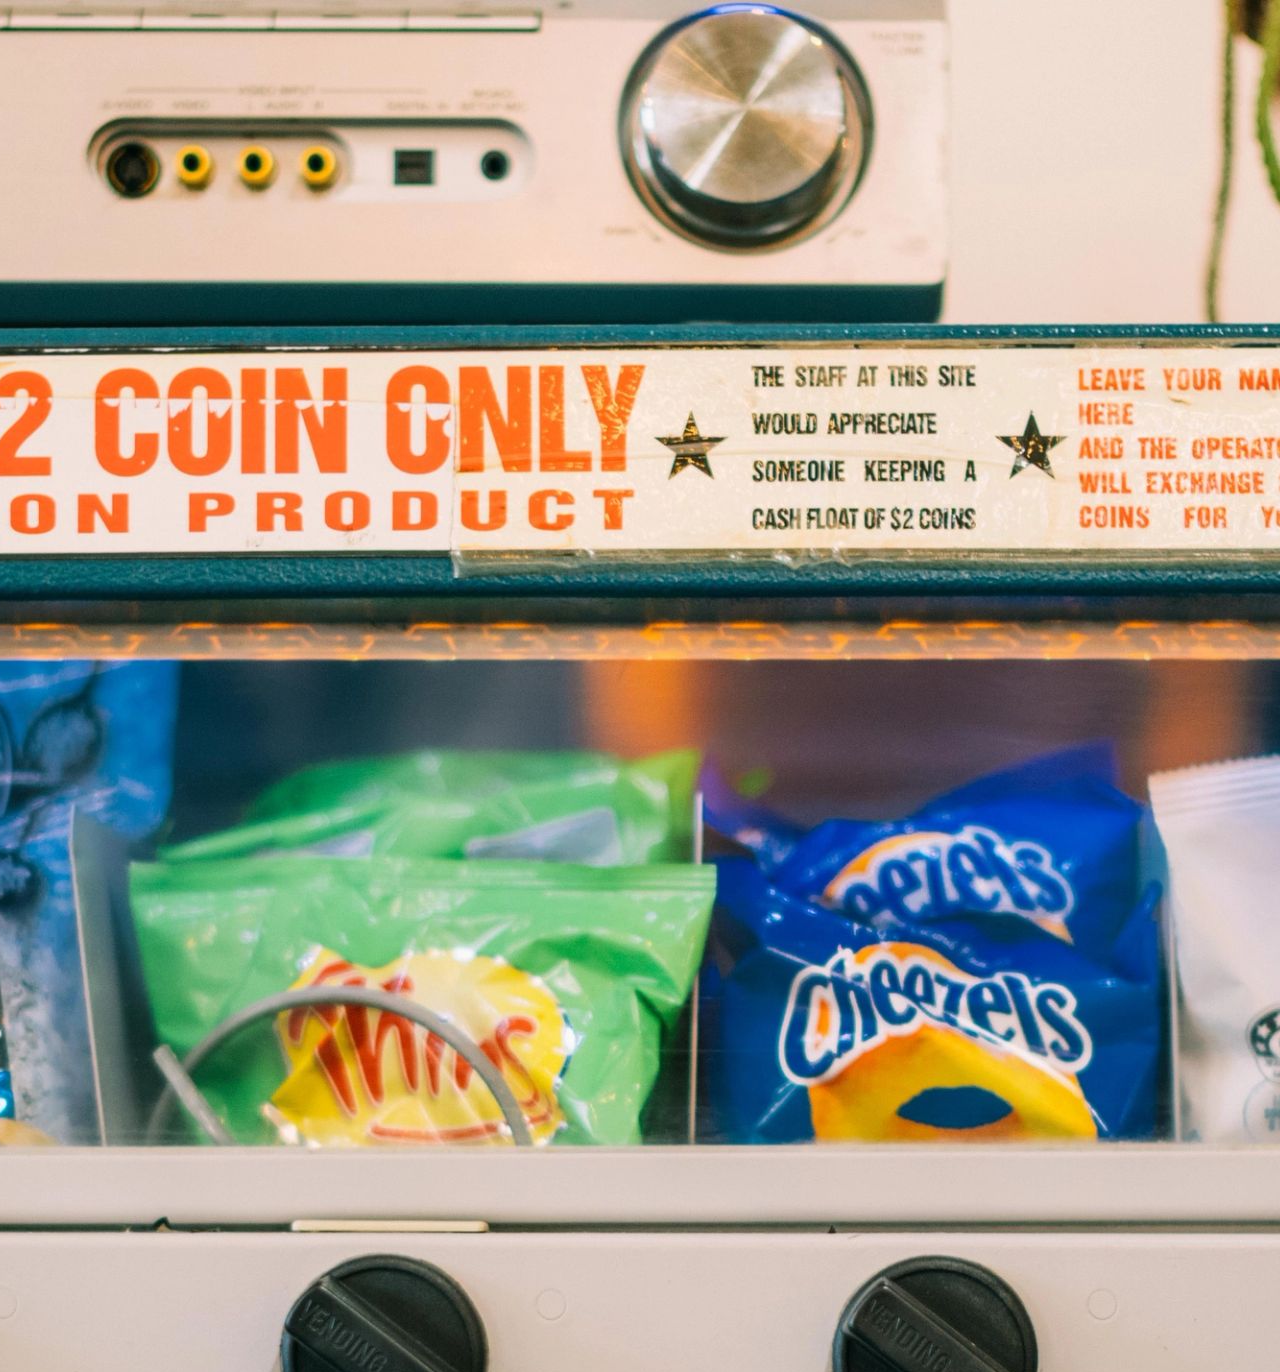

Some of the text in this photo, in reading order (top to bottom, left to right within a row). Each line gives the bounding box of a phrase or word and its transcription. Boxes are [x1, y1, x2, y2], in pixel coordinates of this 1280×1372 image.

[751, 364, 977, 388] THE STAFF AT THIS SITE
[1078, 367, 1146, 392] LEAVE
[1163, 367, 1222, 392] YOUR
[94, 366, 348, 477] COIN
[385, 365, 646, 475] ONLY
[751, 412, 937, 435] WOULD APPRECIATE
[1078, 401, 1134, 426] HERE
[1078, 436, 1124, 460] AND
[1137, 436, 1178, 460] THE
[752, 459, 977, 483] SOMEONE KEEPING A
[1078, 471, 1133, 495] WILL
[1145, 470, 1265, 495] EXCHANGE
[9, 493, 129, 535] ON
[188, 489, 634, 533] PRODUCT
[752, 506, 977, 532] CASH FLOAT OF $2 COINS
[1079, 504, 1151, 529] COINS
[1183, 505, 1228, 529] FOR
[782, 953, 1088, 1081] Cheezels
